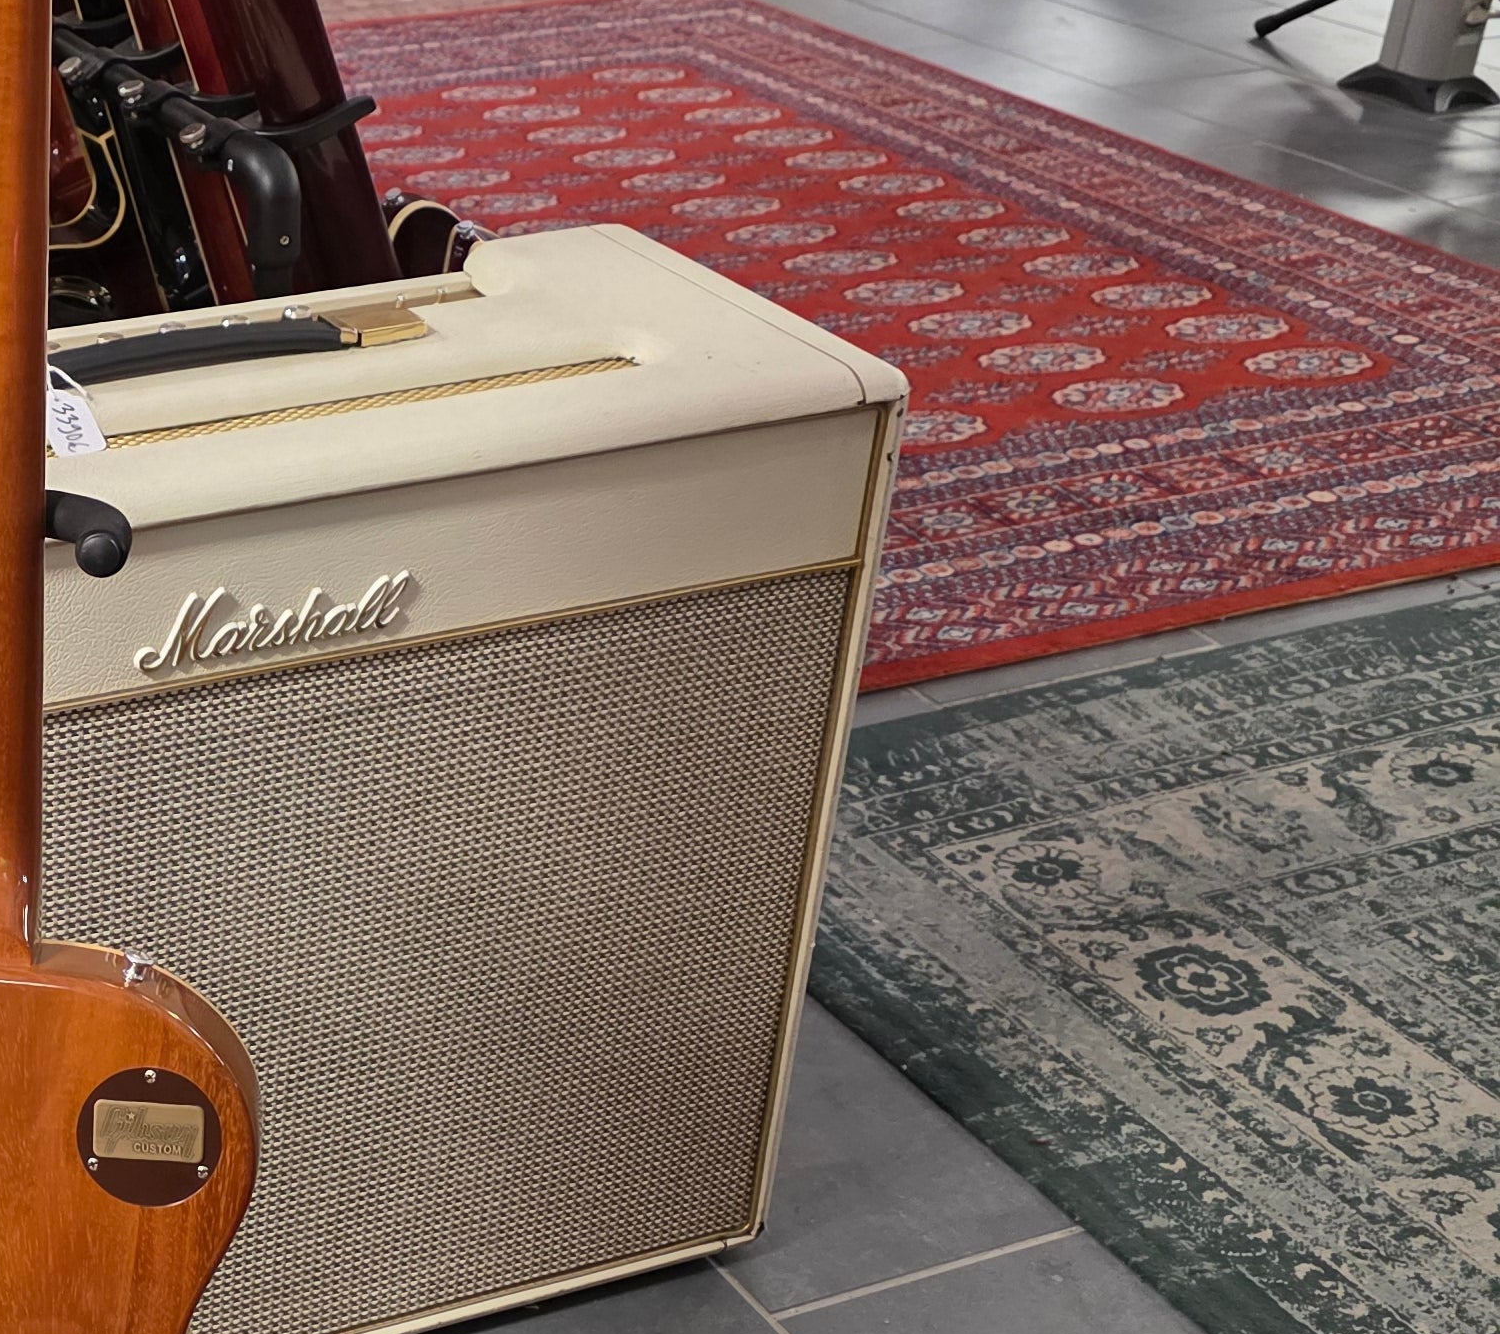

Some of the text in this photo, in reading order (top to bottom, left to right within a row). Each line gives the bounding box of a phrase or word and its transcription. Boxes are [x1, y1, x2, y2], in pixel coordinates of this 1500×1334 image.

[133, 569, 413, 671] Marshall
[99, 1104, 199, 1159] Gibson
[132, 1141, 182, 1157] CUSTOM
